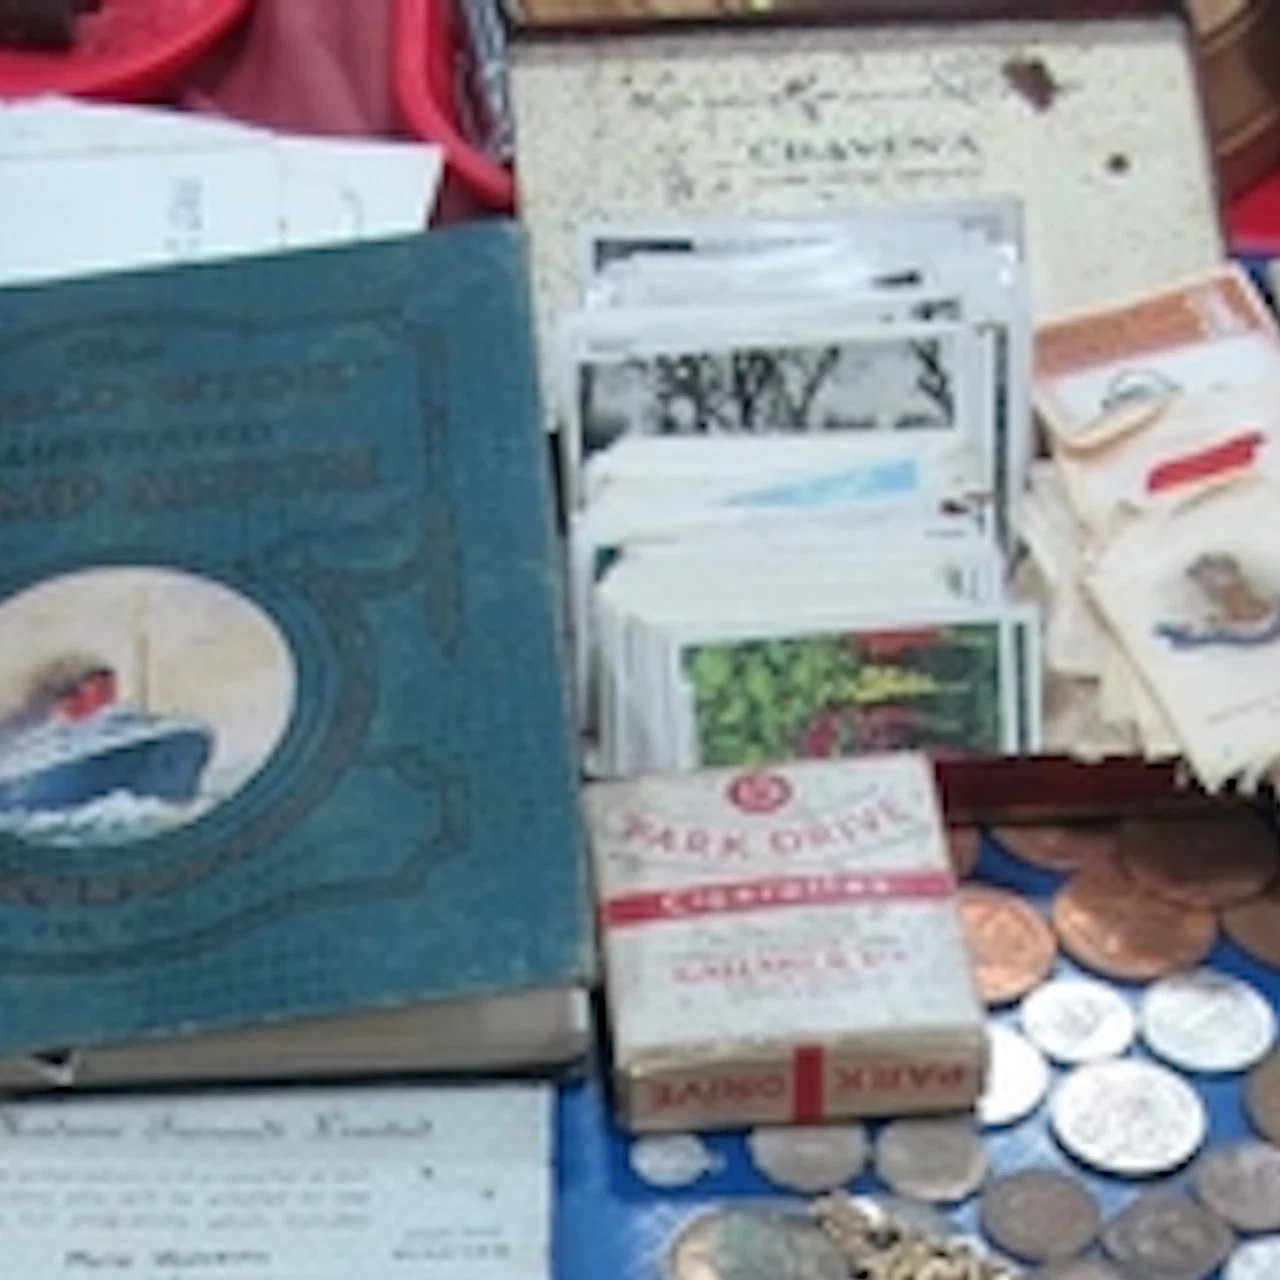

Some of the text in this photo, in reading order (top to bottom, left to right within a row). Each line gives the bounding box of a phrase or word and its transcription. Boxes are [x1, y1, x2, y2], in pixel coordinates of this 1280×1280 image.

[624, 794, 912, 860] PARK DRIVE
[649, 1063, 966, 1113] PARK DRIVE
